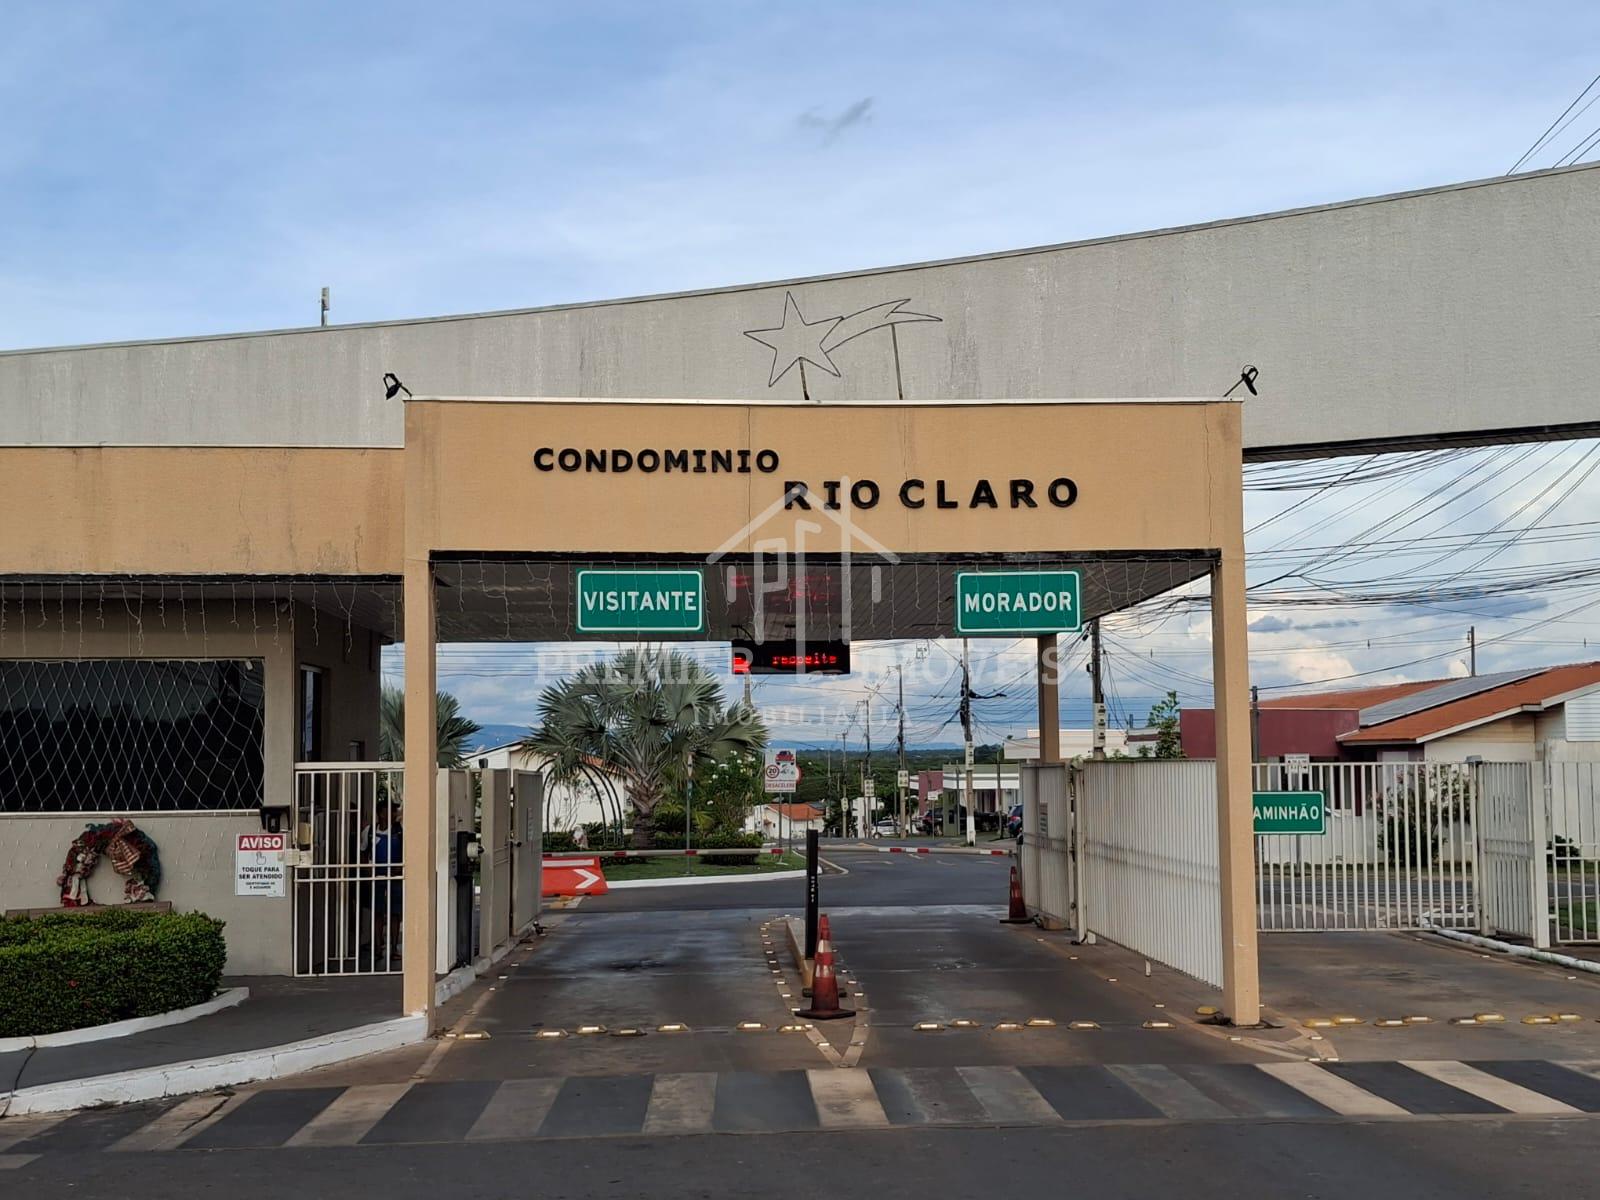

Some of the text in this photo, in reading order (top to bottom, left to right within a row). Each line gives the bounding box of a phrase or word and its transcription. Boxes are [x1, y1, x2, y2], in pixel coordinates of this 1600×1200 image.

[533, 447, 779, 473] CONDOMINIO
[784, 477, 1078, 510] RIO CLARO
[583, 591, 697, 611] VISITANTE
[965, 591, 1072, 612] MORADOR
[1252, 803, 1319, 820] AMINHÃO
[241, 837, 281, 848] AVISO
